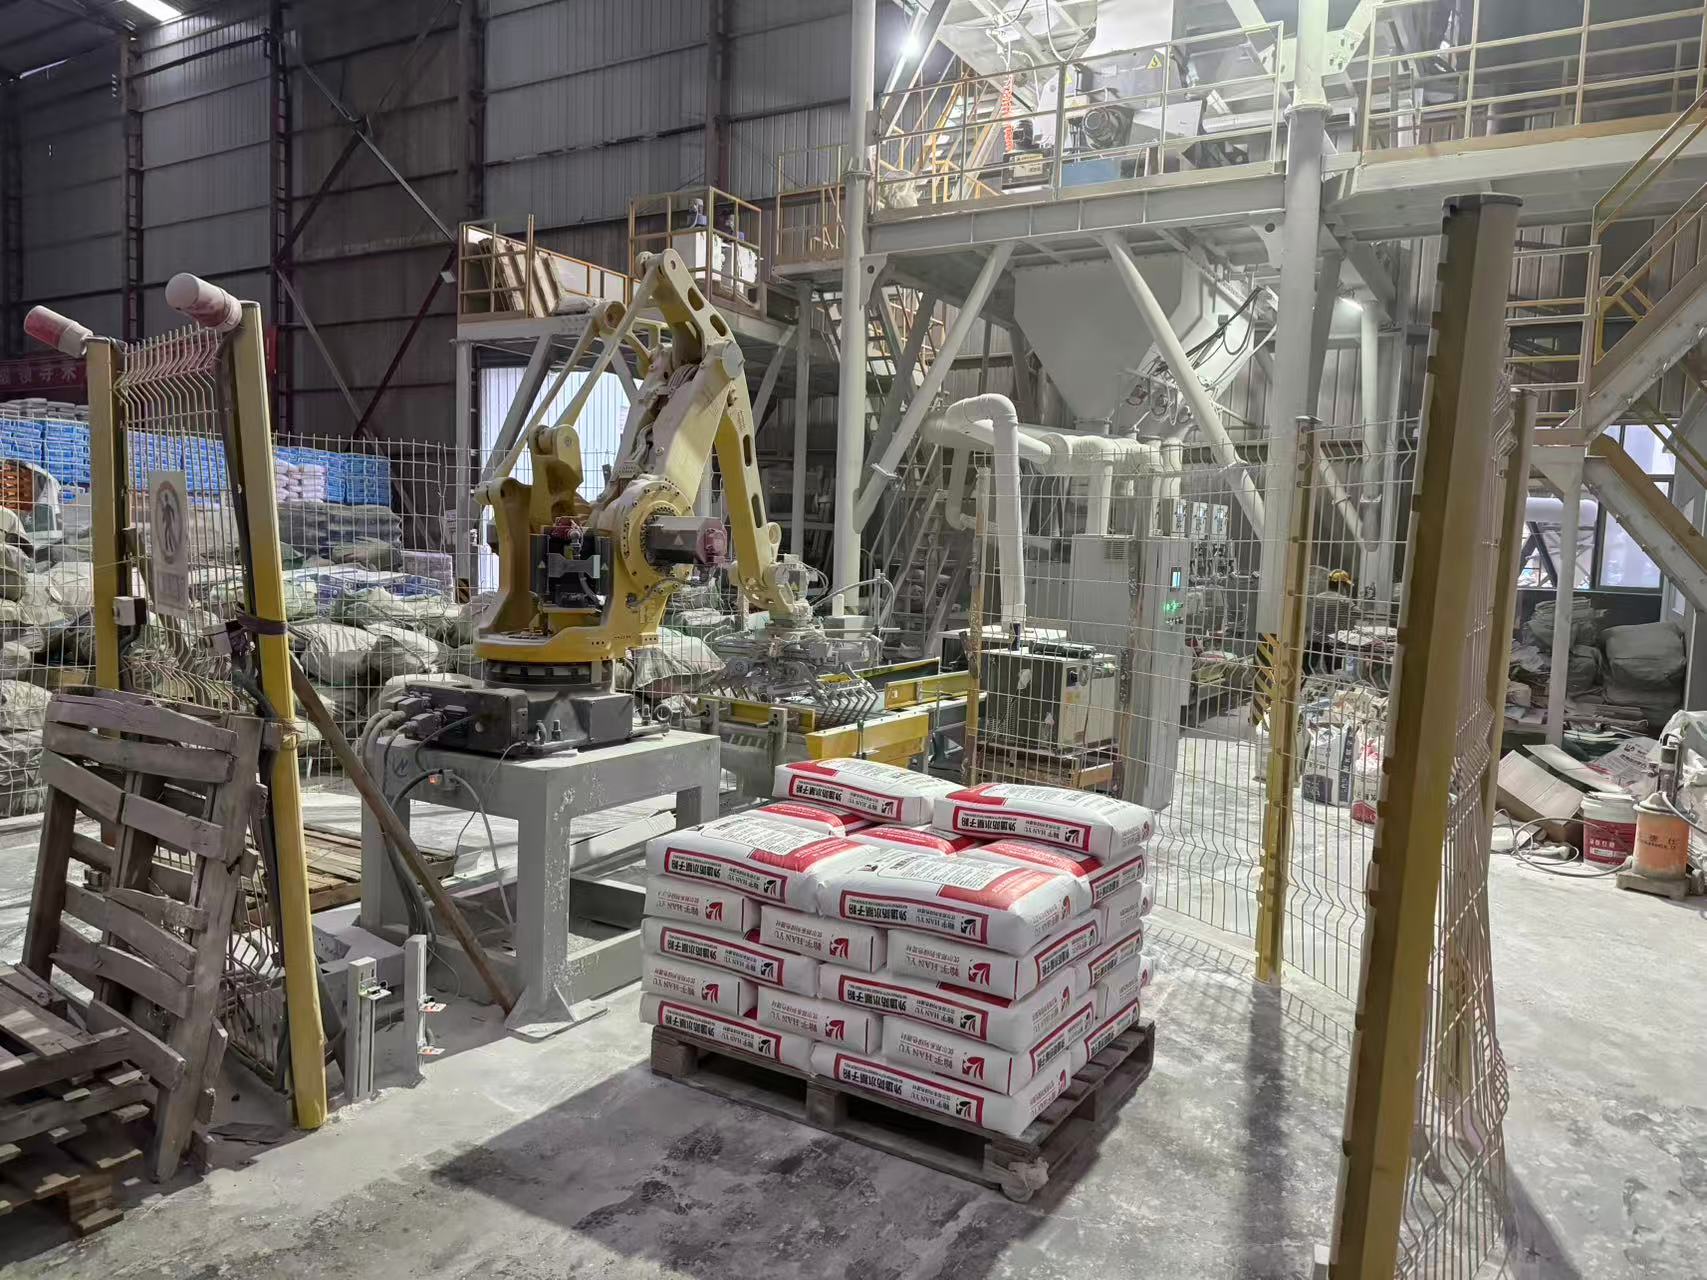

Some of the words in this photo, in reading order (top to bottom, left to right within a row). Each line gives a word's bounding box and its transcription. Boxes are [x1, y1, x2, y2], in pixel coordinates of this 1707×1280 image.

[961, 816, 1016, 832] 外墙防水腻子粉
[849, 904, 907, 921] 外墙防水腻子粉
[925, 918, 940, 926] HAN
[785, 934, 803, 945] HAN
[919, 960, 938, 971] HAN
[663, 981, 679, 990] HAN
[847, 990, 907, 1011] 外墙防水腻子粉
[924, 1010, 940, 1019] HAN
[781, 1015, 799, 1027] HAN
[912, 1048, 932, 1061] HAN
[842, 1068, 902, 1096] 外墙防水腻子粉
[921, 1095, 935, 1105] HAN
